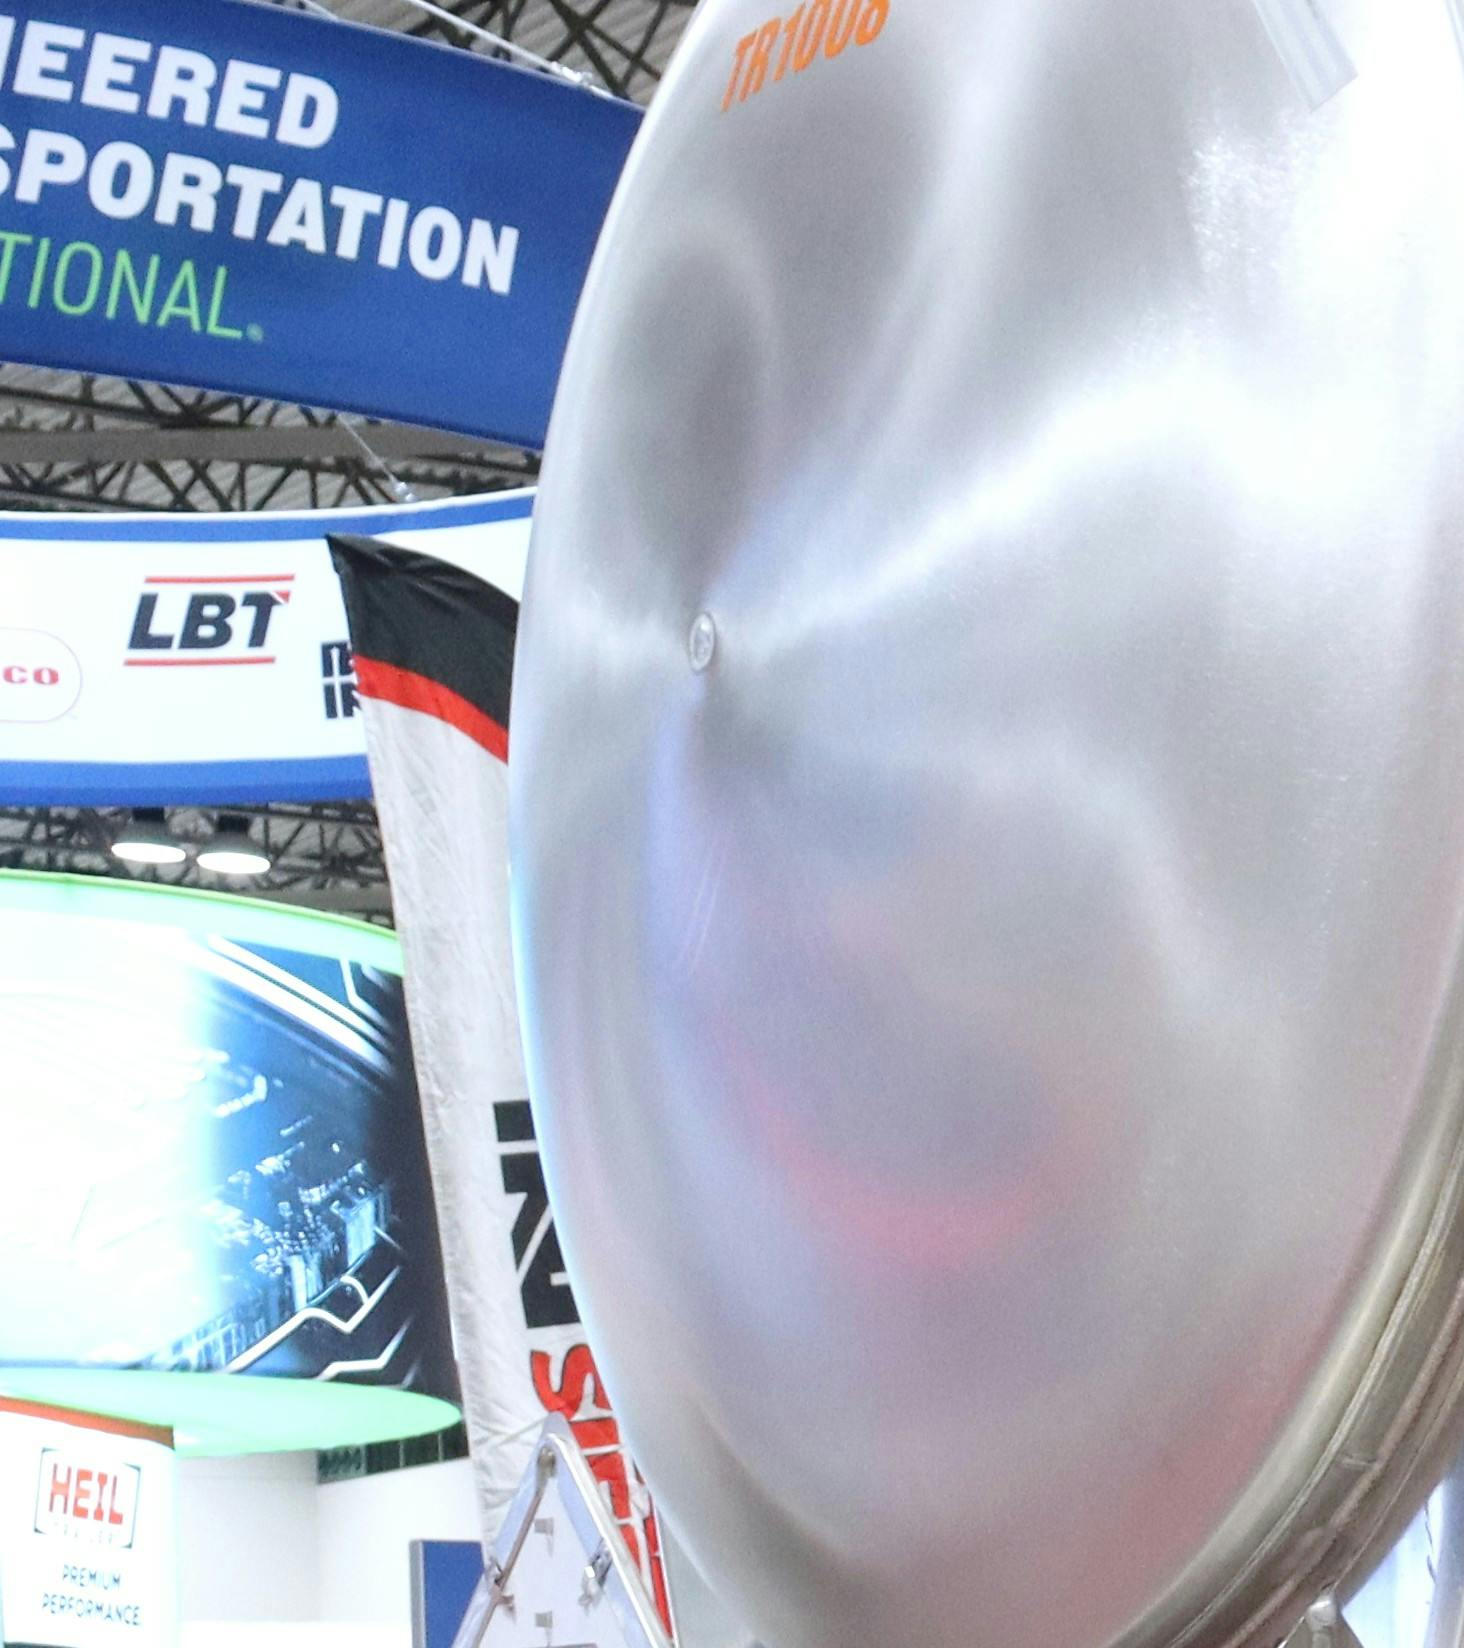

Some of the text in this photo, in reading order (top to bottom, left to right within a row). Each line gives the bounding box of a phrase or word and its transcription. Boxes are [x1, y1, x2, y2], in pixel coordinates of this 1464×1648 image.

[0, 14, 339, 149] EERED
[126, 590, 291, 650] LBT
[48, 1462, 124, 1526] HEIL
[62, 1563, 122, 1591] PREMIUM
